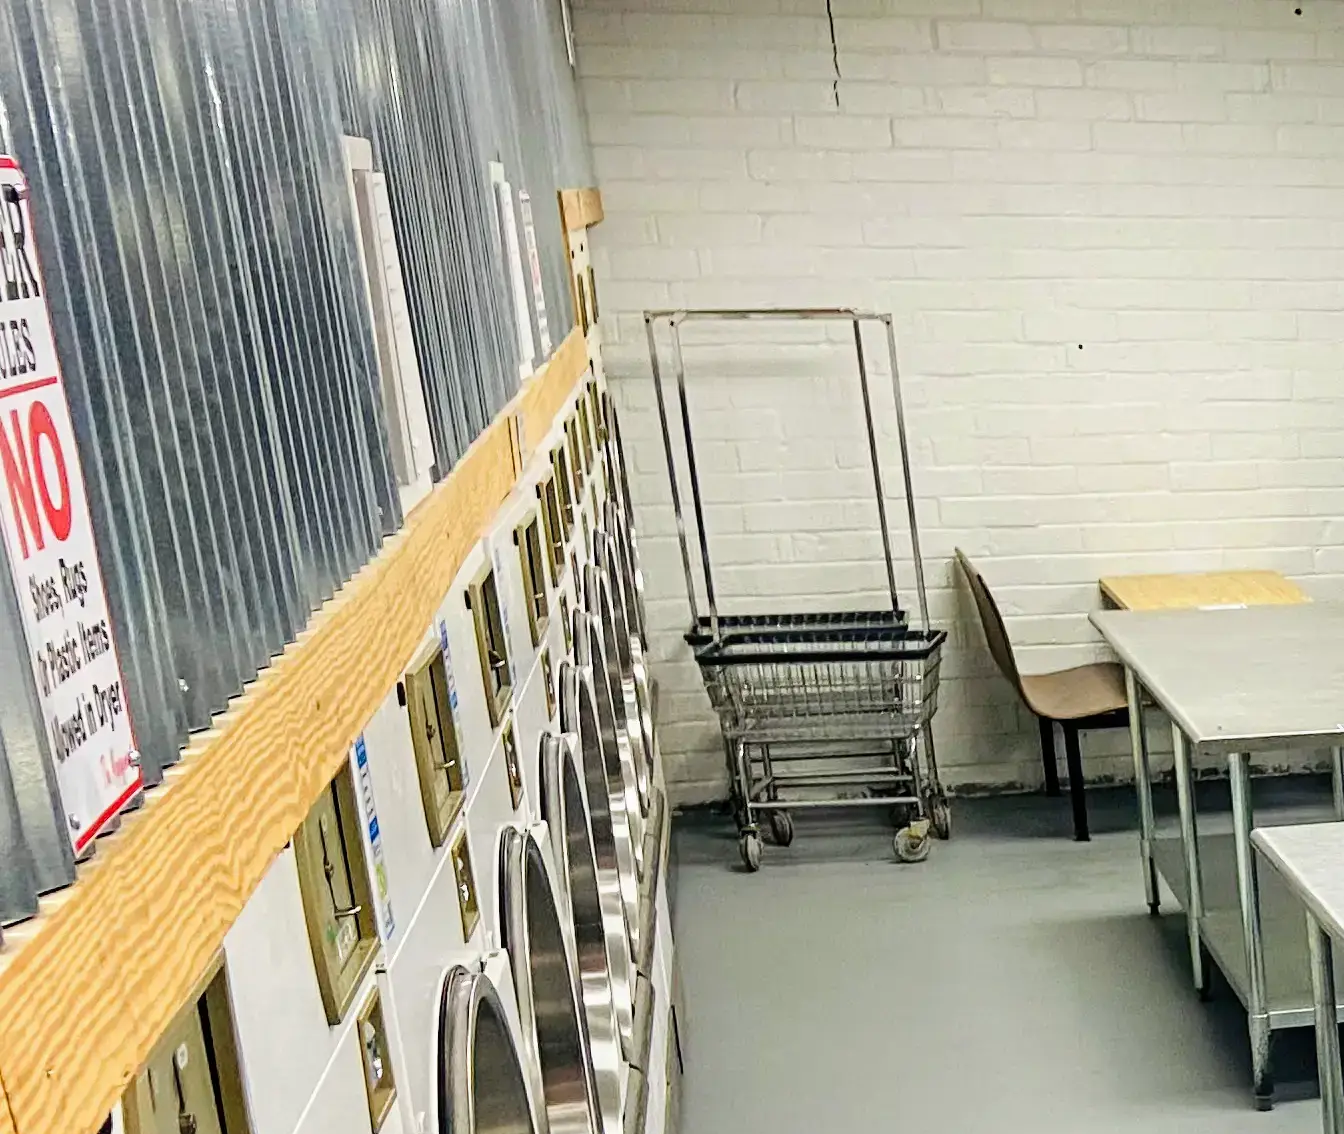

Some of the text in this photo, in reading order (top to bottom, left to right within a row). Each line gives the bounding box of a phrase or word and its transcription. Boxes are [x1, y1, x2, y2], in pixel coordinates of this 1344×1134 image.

[0, 401, 72, 559] NO
[59, 558, 88, 608] Rugs
[46, 629, 81, 689] Plastic
[77, 619, 109, 665] Items
[81, 692, 98, 736] in
[92, 681, 122, 731] Dryer
